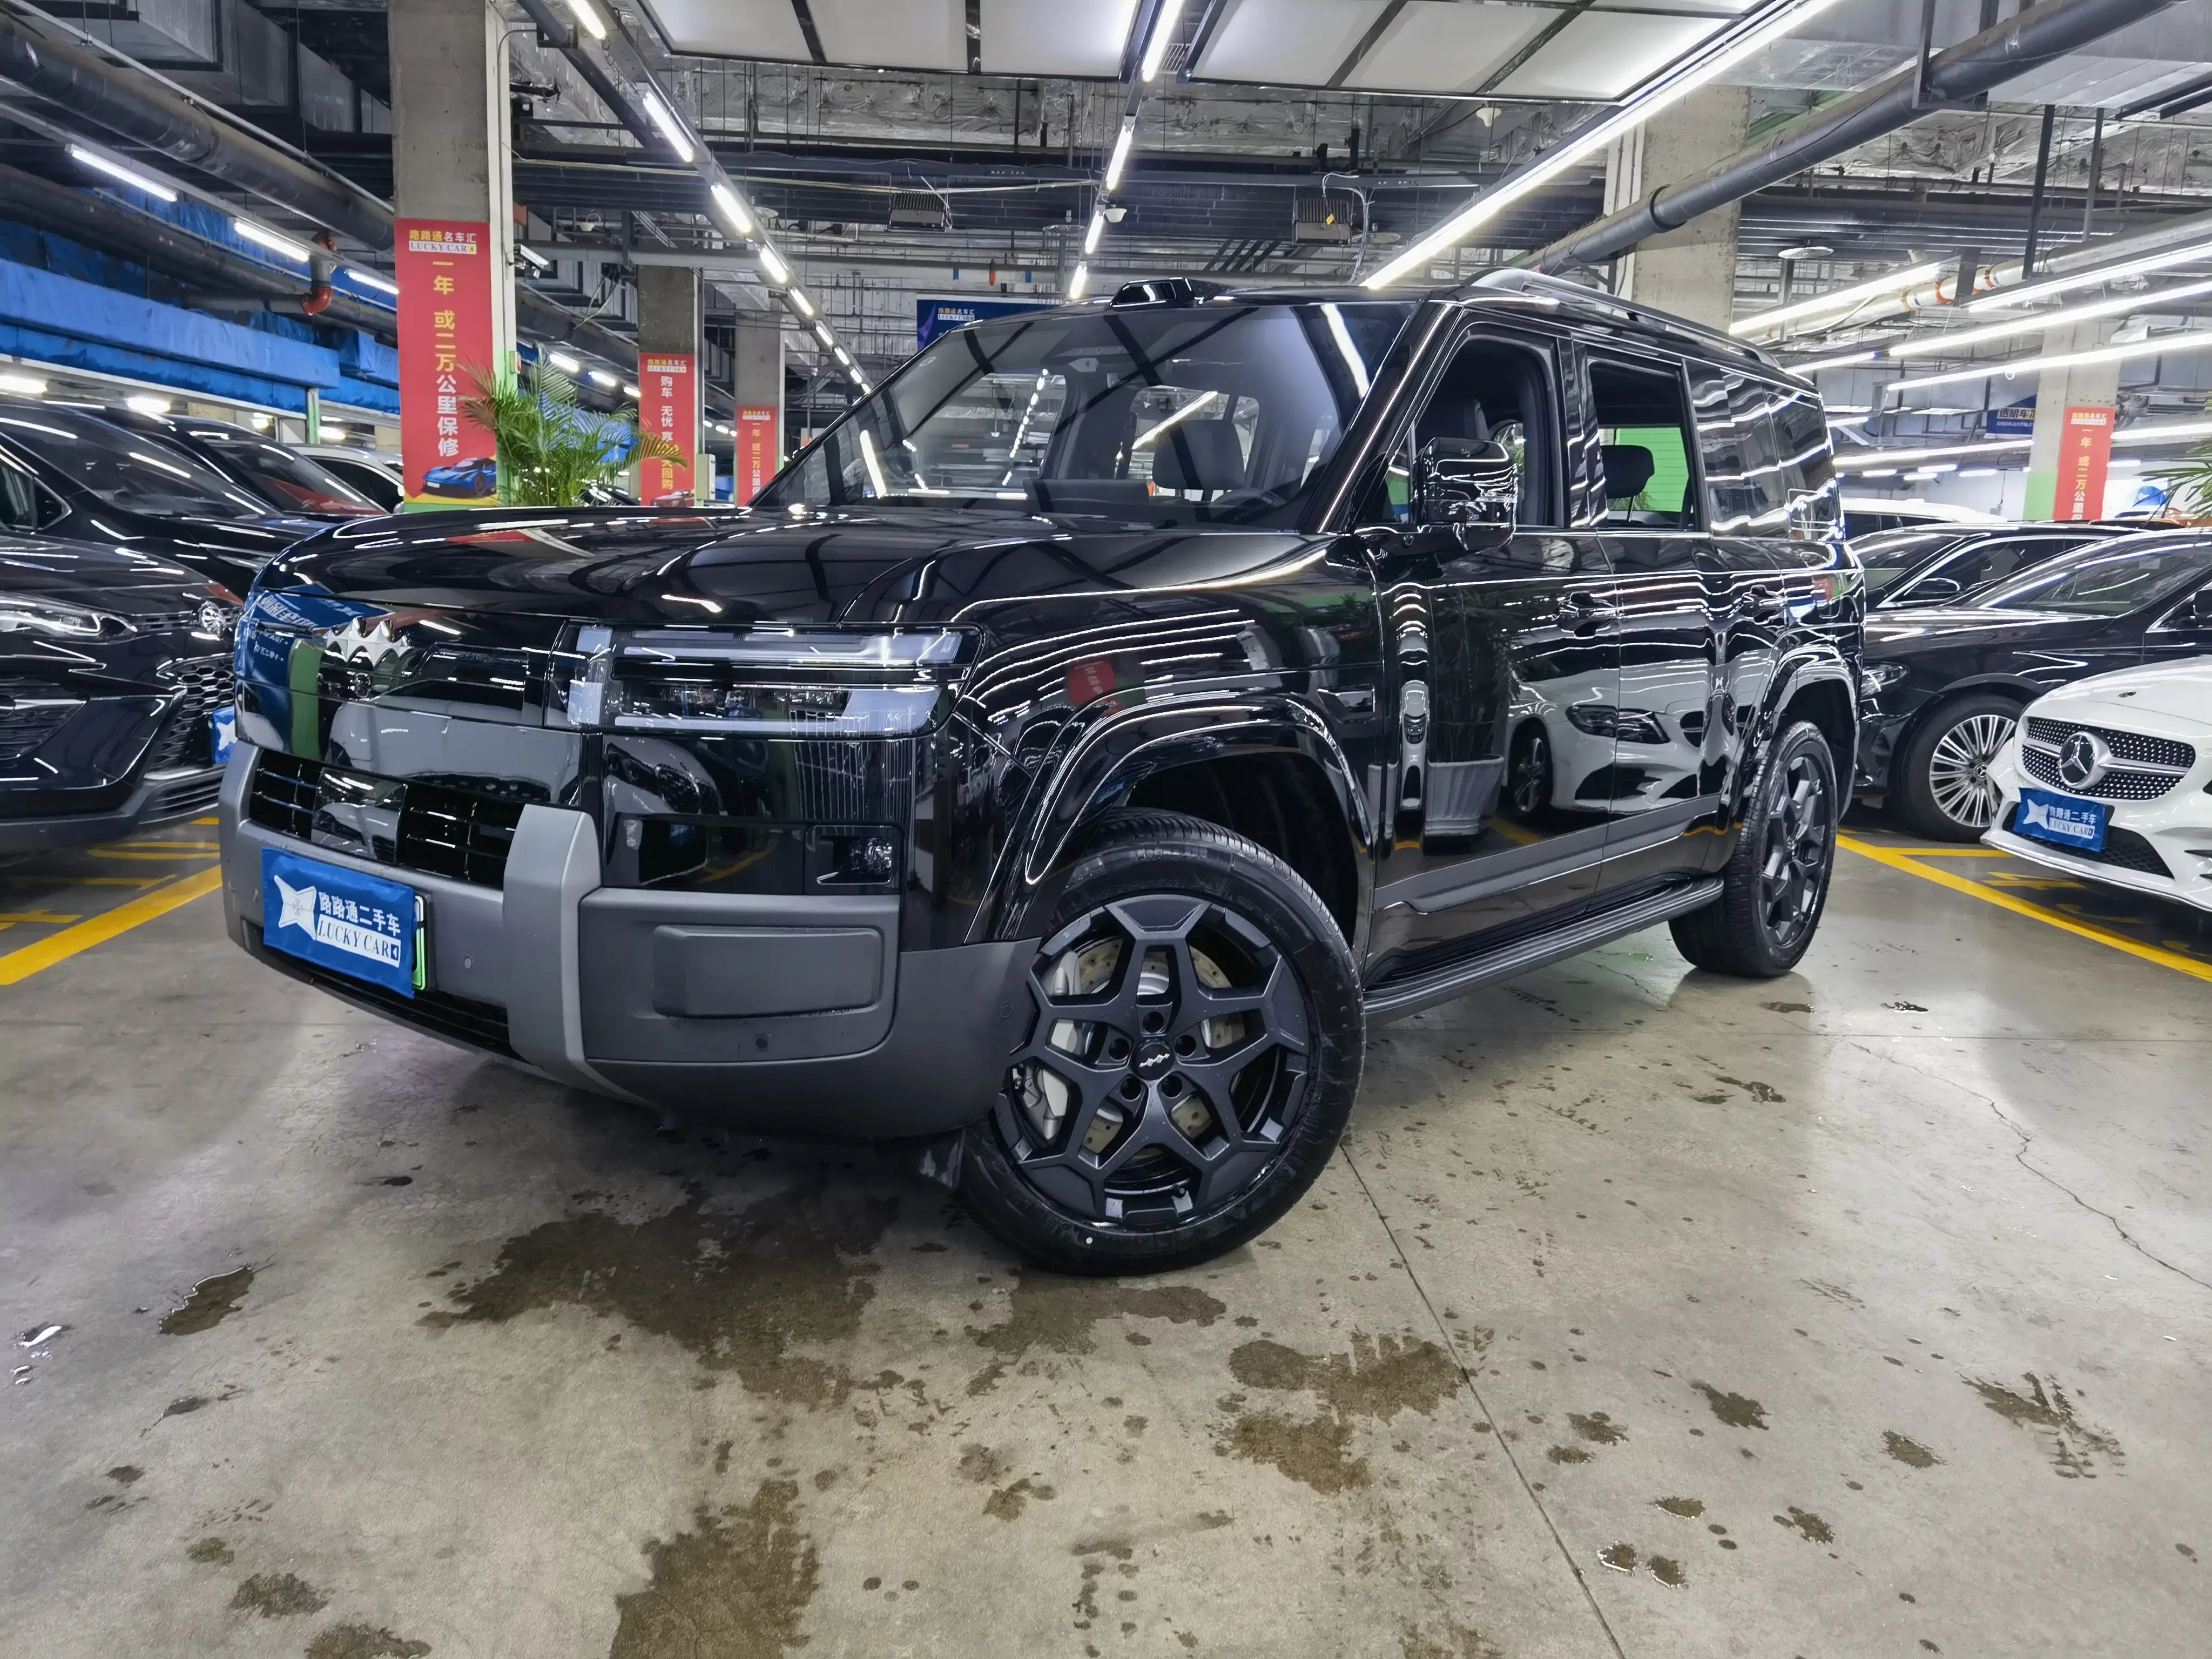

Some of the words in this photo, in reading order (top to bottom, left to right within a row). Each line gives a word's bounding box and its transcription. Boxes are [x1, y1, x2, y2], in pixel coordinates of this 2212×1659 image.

[409, 230, 477, 243] 路路通名车汇
[410, 241, 444, 251] LUCKY
[447, 244, 467, 252] CAR
[2049, 820, 2072, 832] LUCKY
[2074, 825, 2088, 835] CAR
[319, 892, 401, 936] 路路通二手车
[318, 920, 362, 947] LUCKY
[363, 934, 389, 958] CAR
